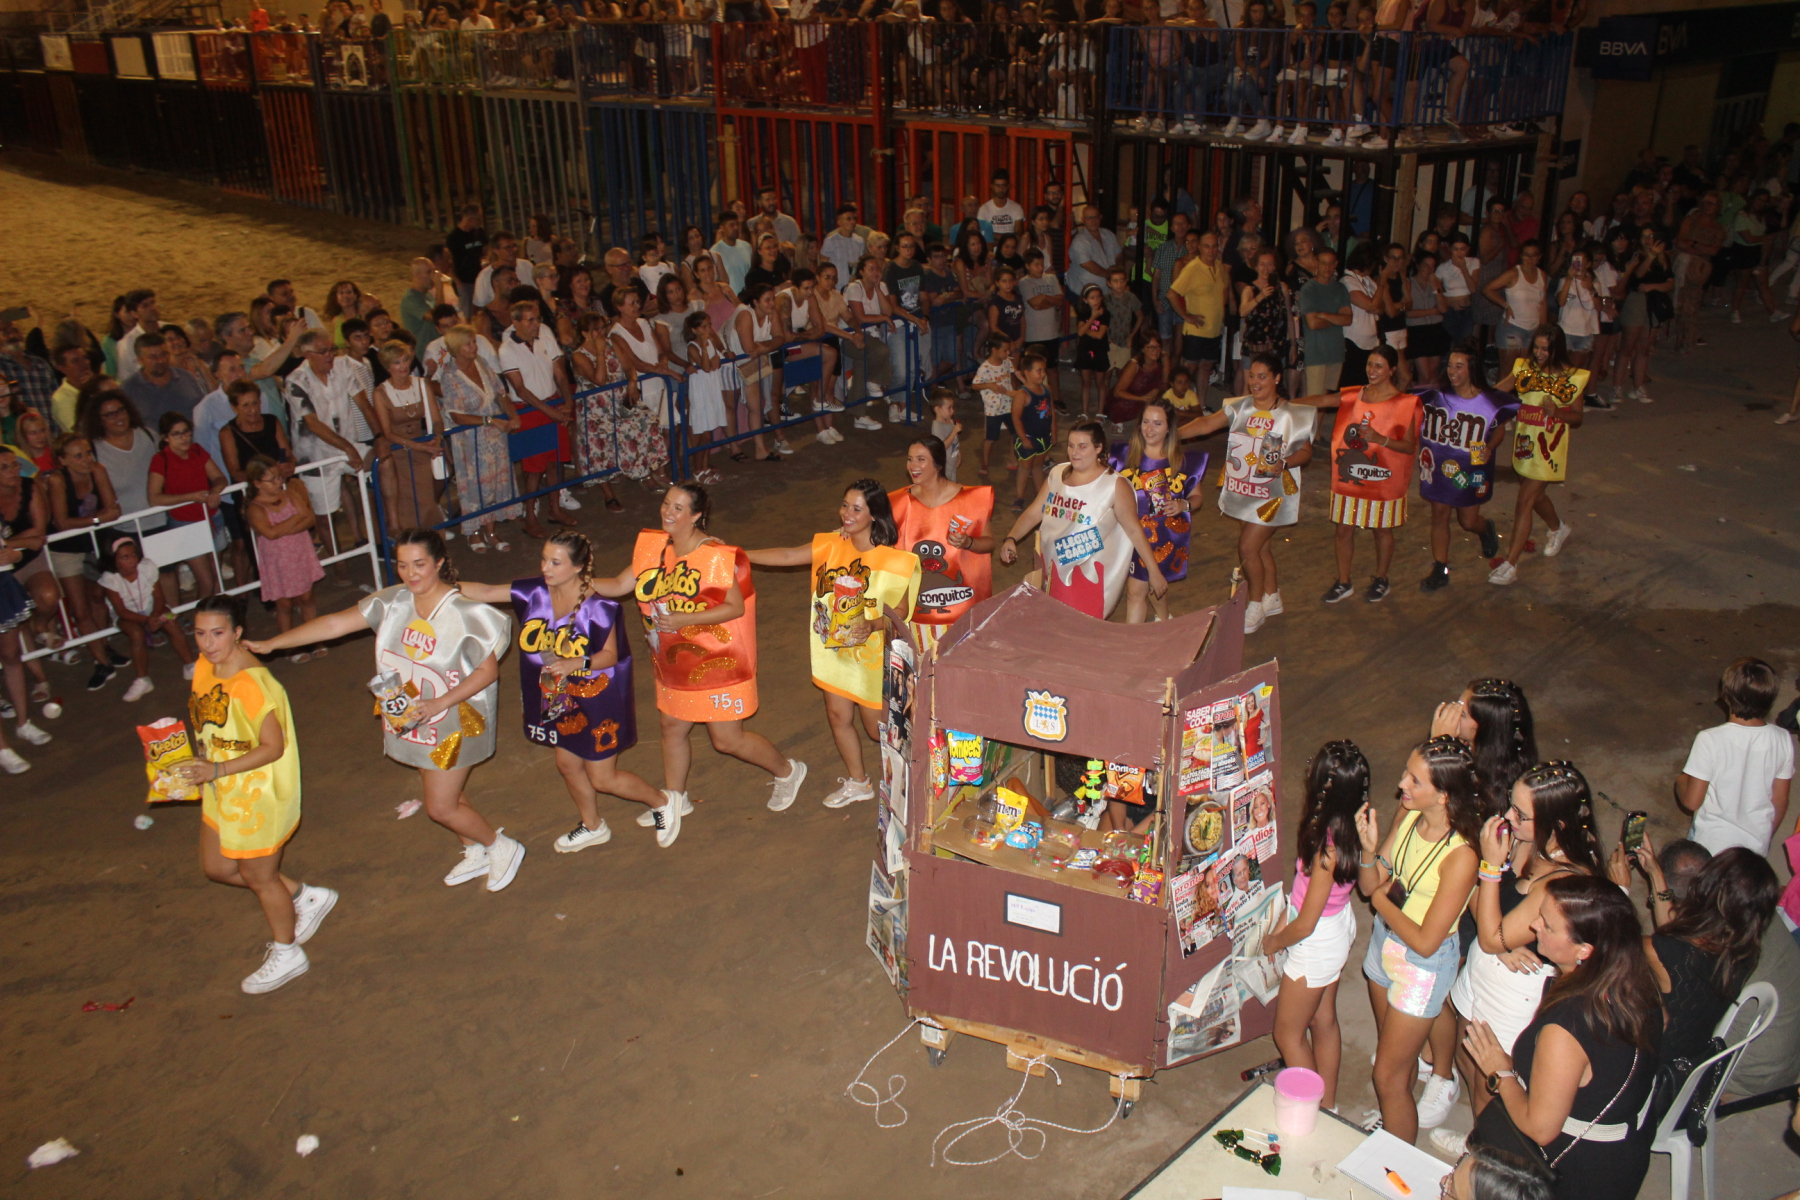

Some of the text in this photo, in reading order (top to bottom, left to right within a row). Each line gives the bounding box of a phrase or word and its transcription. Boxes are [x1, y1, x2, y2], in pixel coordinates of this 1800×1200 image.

[1600, 41, 1648, 56] BBVA
[1656, 23, 1688, 55] BVA
[1246, 416, 1272, 435] Lay's
[1227, 478, 1270, 498] BUGLES
[1046, 491, 1088, 511] Kinder
[635, 561, 702, 603] Cheetos
[919, 588, 973, 606] conguitos
[402, 627, 437, 660] Lay's
[1186, 705, 1211, 721] SABER
[1108, 762, 1139, 775] Doritos
[1174, 873, 1205, 897] pronto
[929, 934, 957, 974] LA
